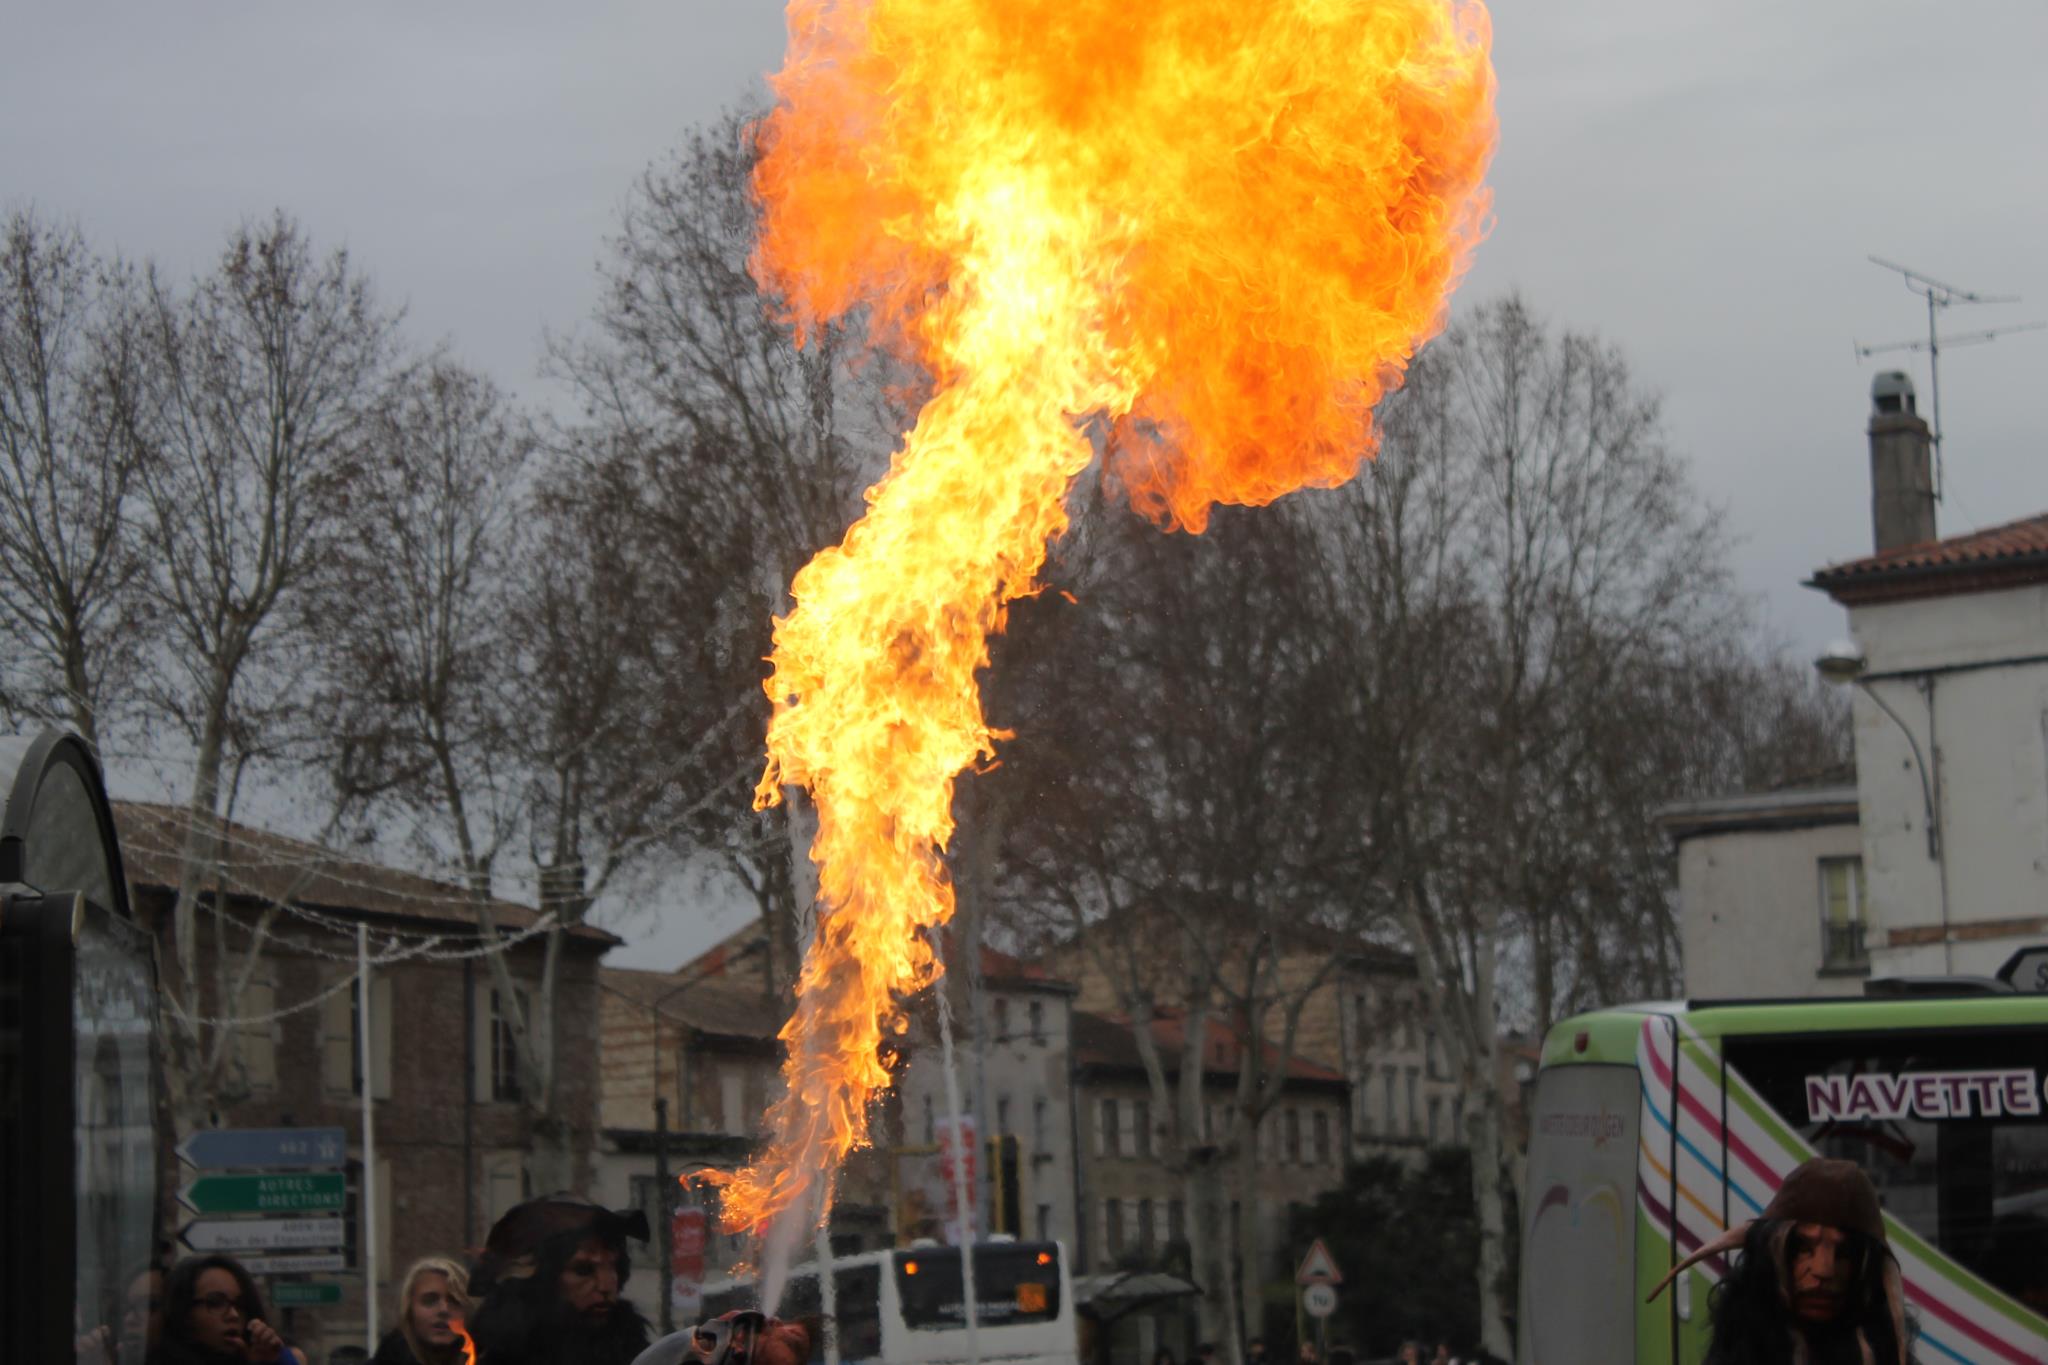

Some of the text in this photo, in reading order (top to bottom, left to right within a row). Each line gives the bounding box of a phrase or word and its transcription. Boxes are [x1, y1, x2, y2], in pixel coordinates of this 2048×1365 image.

[1805, 1068, 2039, 1121] NAVETTE
[258, 1179, 313, 1192] AUTRES
[258, 1192, 341, 1207] DIRECTIONS
